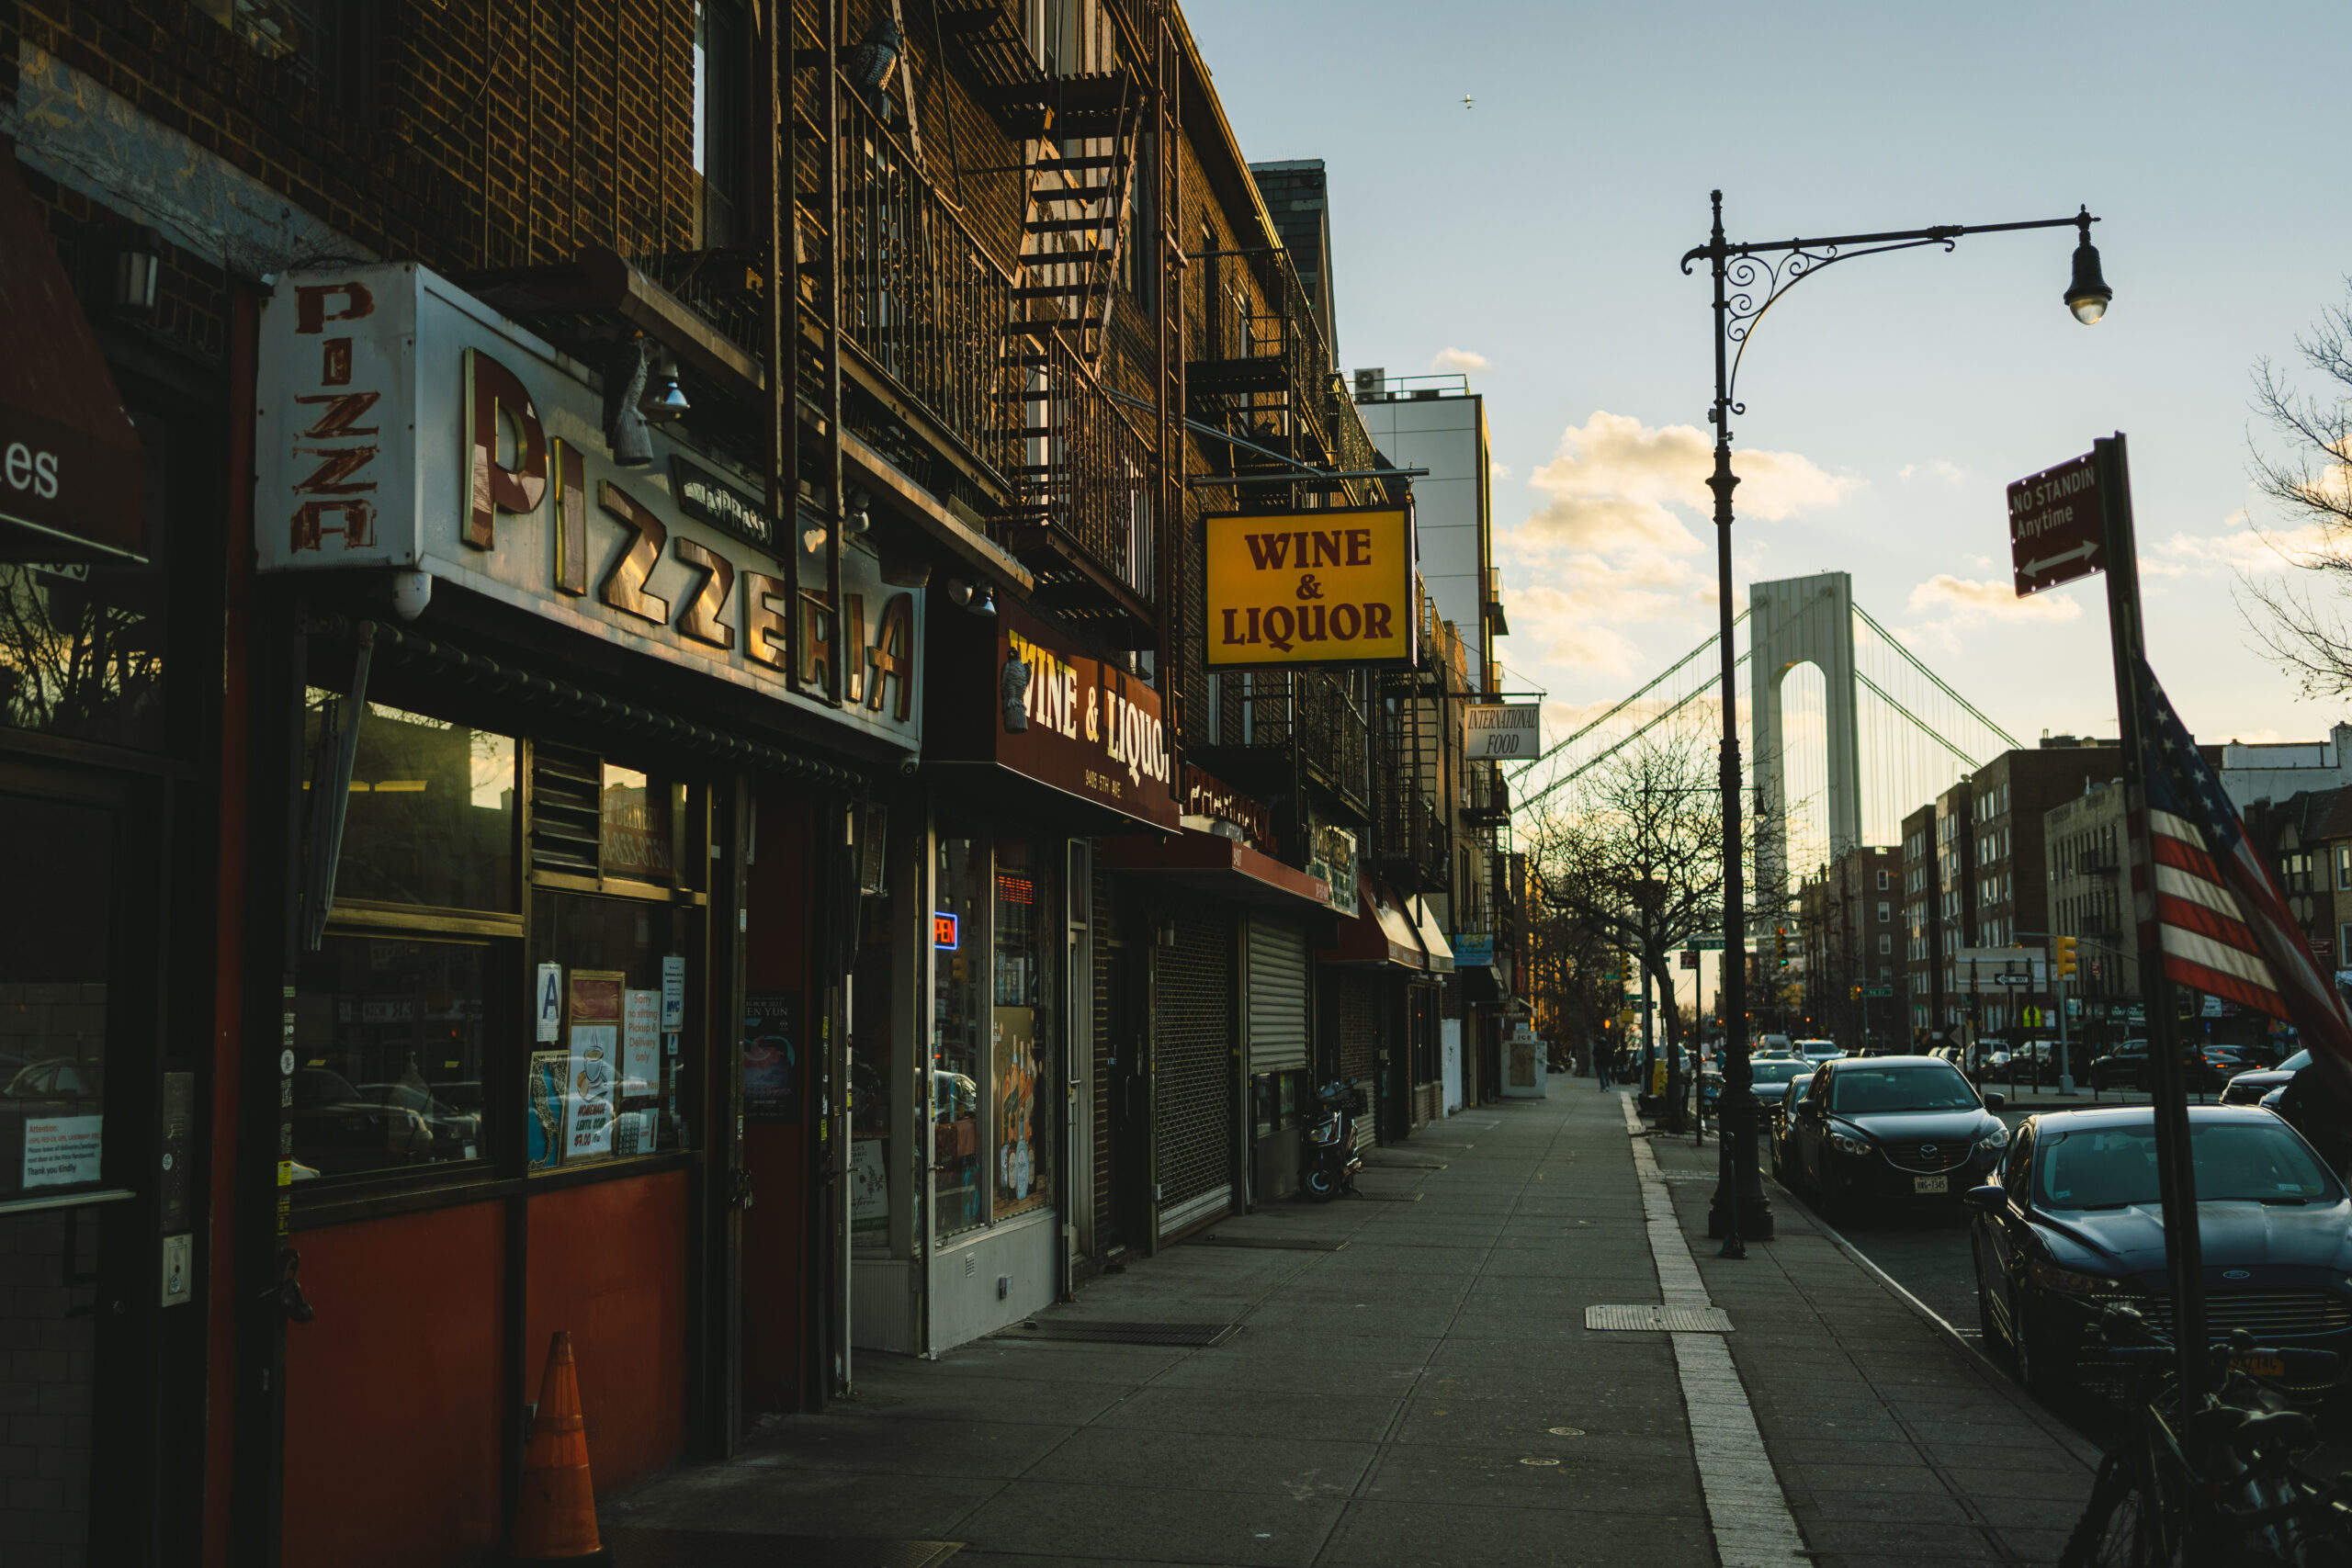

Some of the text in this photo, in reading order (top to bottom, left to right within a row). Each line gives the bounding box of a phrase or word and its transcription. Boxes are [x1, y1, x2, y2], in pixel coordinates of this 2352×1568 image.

[291, 281, 380, 554] PIZZA
[4, 442, 59, 500] es
[2014, 467, 2096, 515] NO STANDIN
[706, 482, 773, 547] ESPRESSO
[2018, 506, 2074, 539] Anytime
[462, 346, 913, 722] PIZZERIA
[1245, 528, 1372, 570] WINE
[1296, 573, 1324, 601] &
[1222, 603, 1394, 653] LIQUOR
[1468, 709, 1536, 729] INTERNATIONAL
[1086, 686, 1099, 743] &
[1108, 690, 1170, 788] LIQUO
[1486, 735, 1521, 755] FOOD
[1099, 774, 1110, 795] 5TH
[616, 800, 660, 831] DELIVERY
[604, 829, 670, 869] 8-833-8750
[934, 918, 956, 943] PEN
[543, 973, 559, 1019] A
[634, 993, 652, 1007] Sorry
[637, 1009, 659, 1021] sitting
[746, 1007, 788, 1016] EN YUN
[628, 1022, 650, 1034] Pickup
[628, 1037, 657, 1049] Delivery
[635, 1051, 650, 1064] only
[646, 1080, 659, 1090] You
[28, 1167, 45, 1176] Thank
[47, 1168, 57, 1176] you
